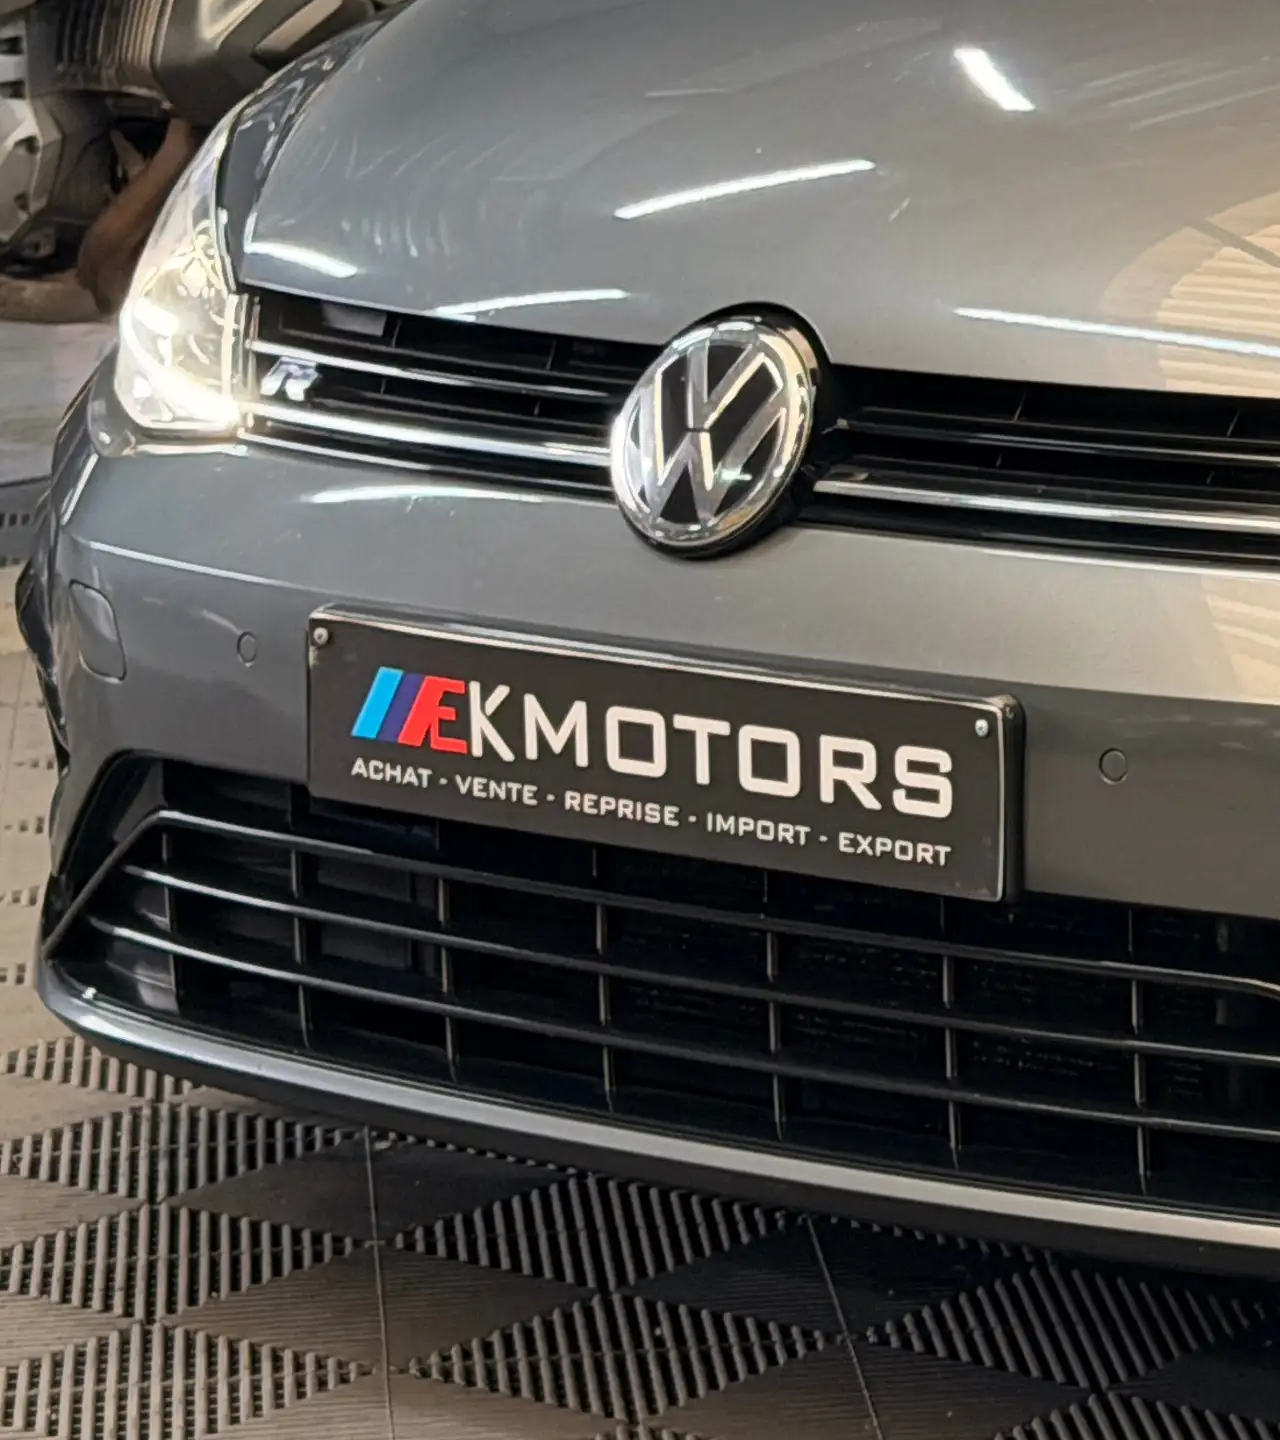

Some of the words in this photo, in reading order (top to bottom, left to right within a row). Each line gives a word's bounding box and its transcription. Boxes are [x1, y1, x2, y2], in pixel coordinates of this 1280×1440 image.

[351, 757, 432, 788] ACHAT
[455, 775, 538, 805] VENTE
[564, 790, 680, 827] REPRISE
[706, 812, 811, 846] IMPORT
[838, 832, 952, 866] EXPORT
